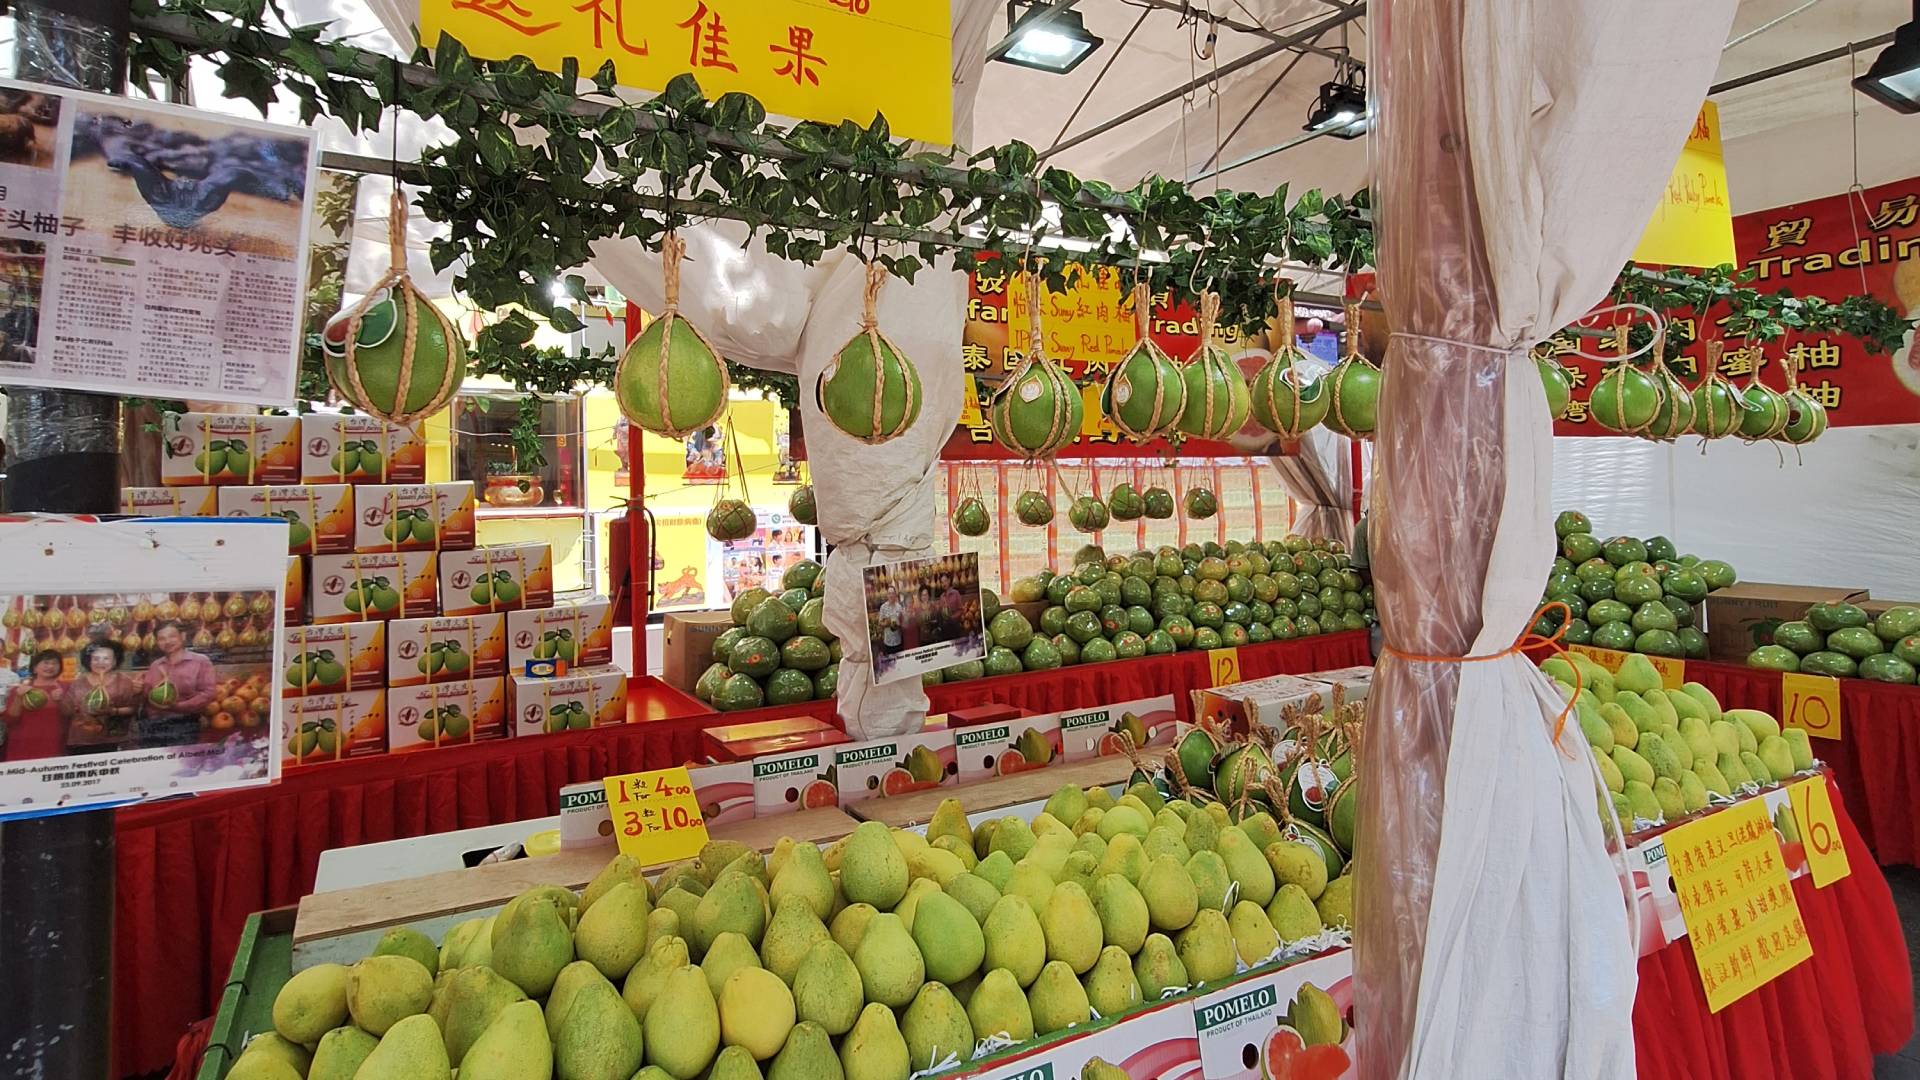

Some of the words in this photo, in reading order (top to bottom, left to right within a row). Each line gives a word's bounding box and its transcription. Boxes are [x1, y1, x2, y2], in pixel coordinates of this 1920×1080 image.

[1066, 712, 1106, 727] POMELO
[1789, 692, 1831, 730] 10
[961, 728, 1006, 744] POMELO
[71, 760, 108, 769] Festival
[110, 754, 164, 766] Celebration
[842, 745, 892, 763] POMELO
[842, 761, 863, 769] PRODUCT
[871, 756, 893, 764] THAILAND
[759, 757, 813, 775] POMELO
[759, 774, 782, 782] PRODUCT
[791, 769, 814, 777] THAILAND
[618, 780, 630, 803] 1
[634, 792, 650, 802] For
[623, 811, 643, 837] 3
[647, 823, 661, 833] For
[1203, 989, 1270, 1026] POMELO
[1206, 1023, 1234, 1038] PRODUCT
[1244, 1008, 1272, 1023] THAILAND
